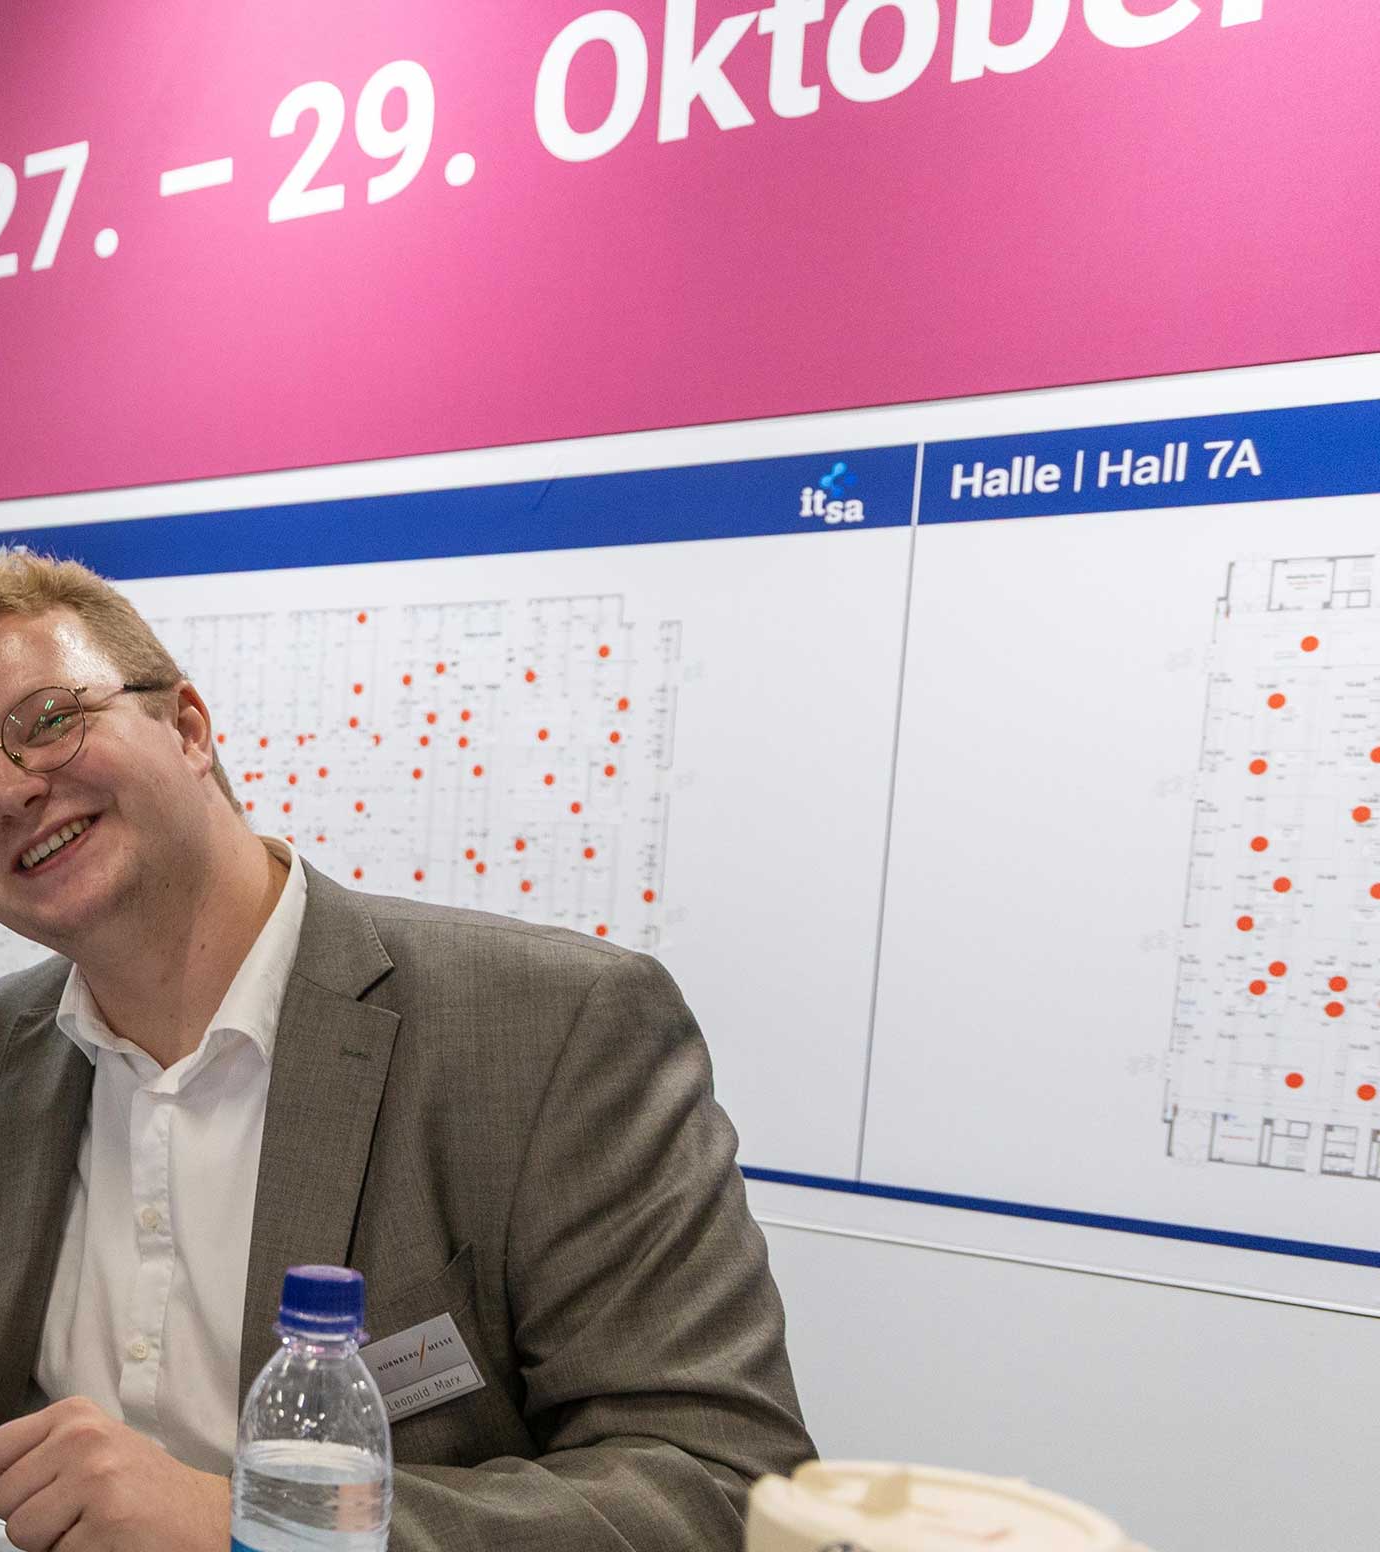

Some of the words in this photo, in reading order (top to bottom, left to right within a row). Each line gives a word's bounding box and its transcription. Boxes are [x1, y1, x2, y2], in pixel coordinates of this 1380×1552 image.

[267, 59, 476, 224] 29.
[534, 0, 1264, 162] Oktob
[951, 455, 1061, 499] Halle
[1098, 442, 1188, 489] Hall
[1203, 438, 1261, 480] 7A
[386, 1386, 431, 1412] Leopold
[433, 1375, 462, 1393] Marx
